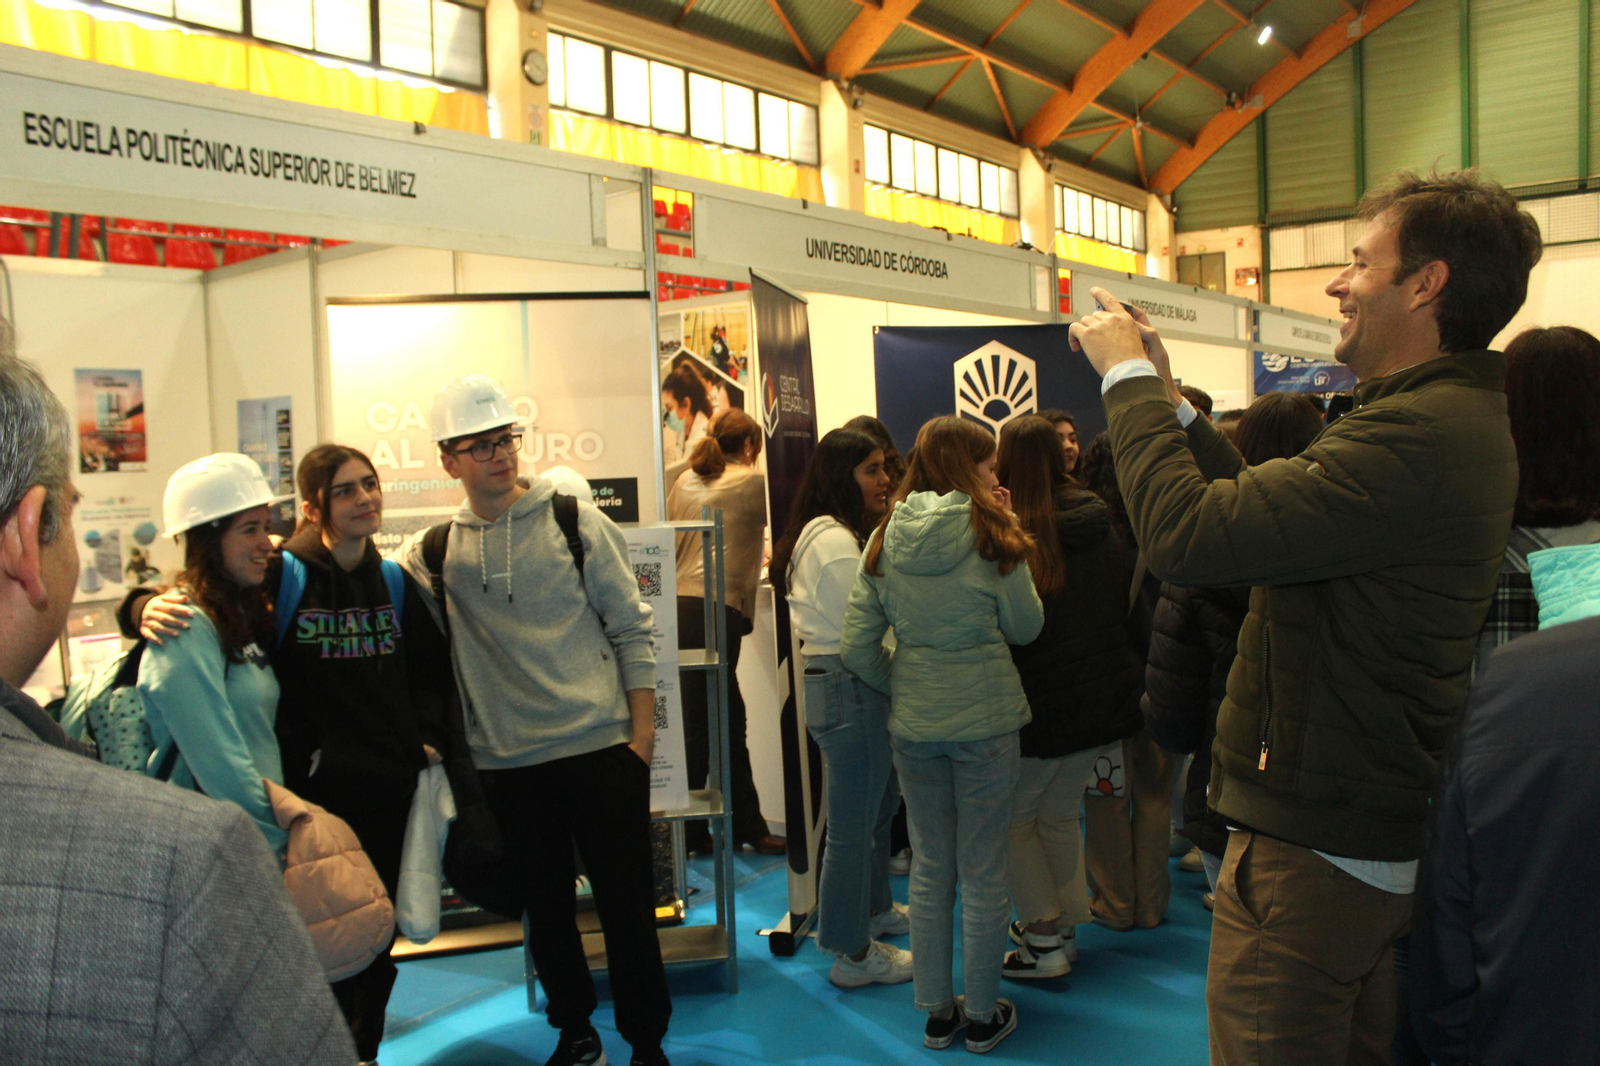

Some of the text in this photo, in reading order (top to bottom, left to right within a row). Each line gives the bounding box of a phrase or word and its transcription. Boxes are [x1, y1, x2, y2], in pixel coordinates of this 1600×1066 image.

[23, 111, 417, 198] ESCUELA POLITÉCNICA SUPERIOR DE BELMEZ
[806, 237, 949, 279] UNIVERSIDAD DE CÓRDOBA
[1166, 304, 1175, 319] DE
[1175, 303, 1198, 322] MÁLAGA
[371, 438, 425, 470] AL
